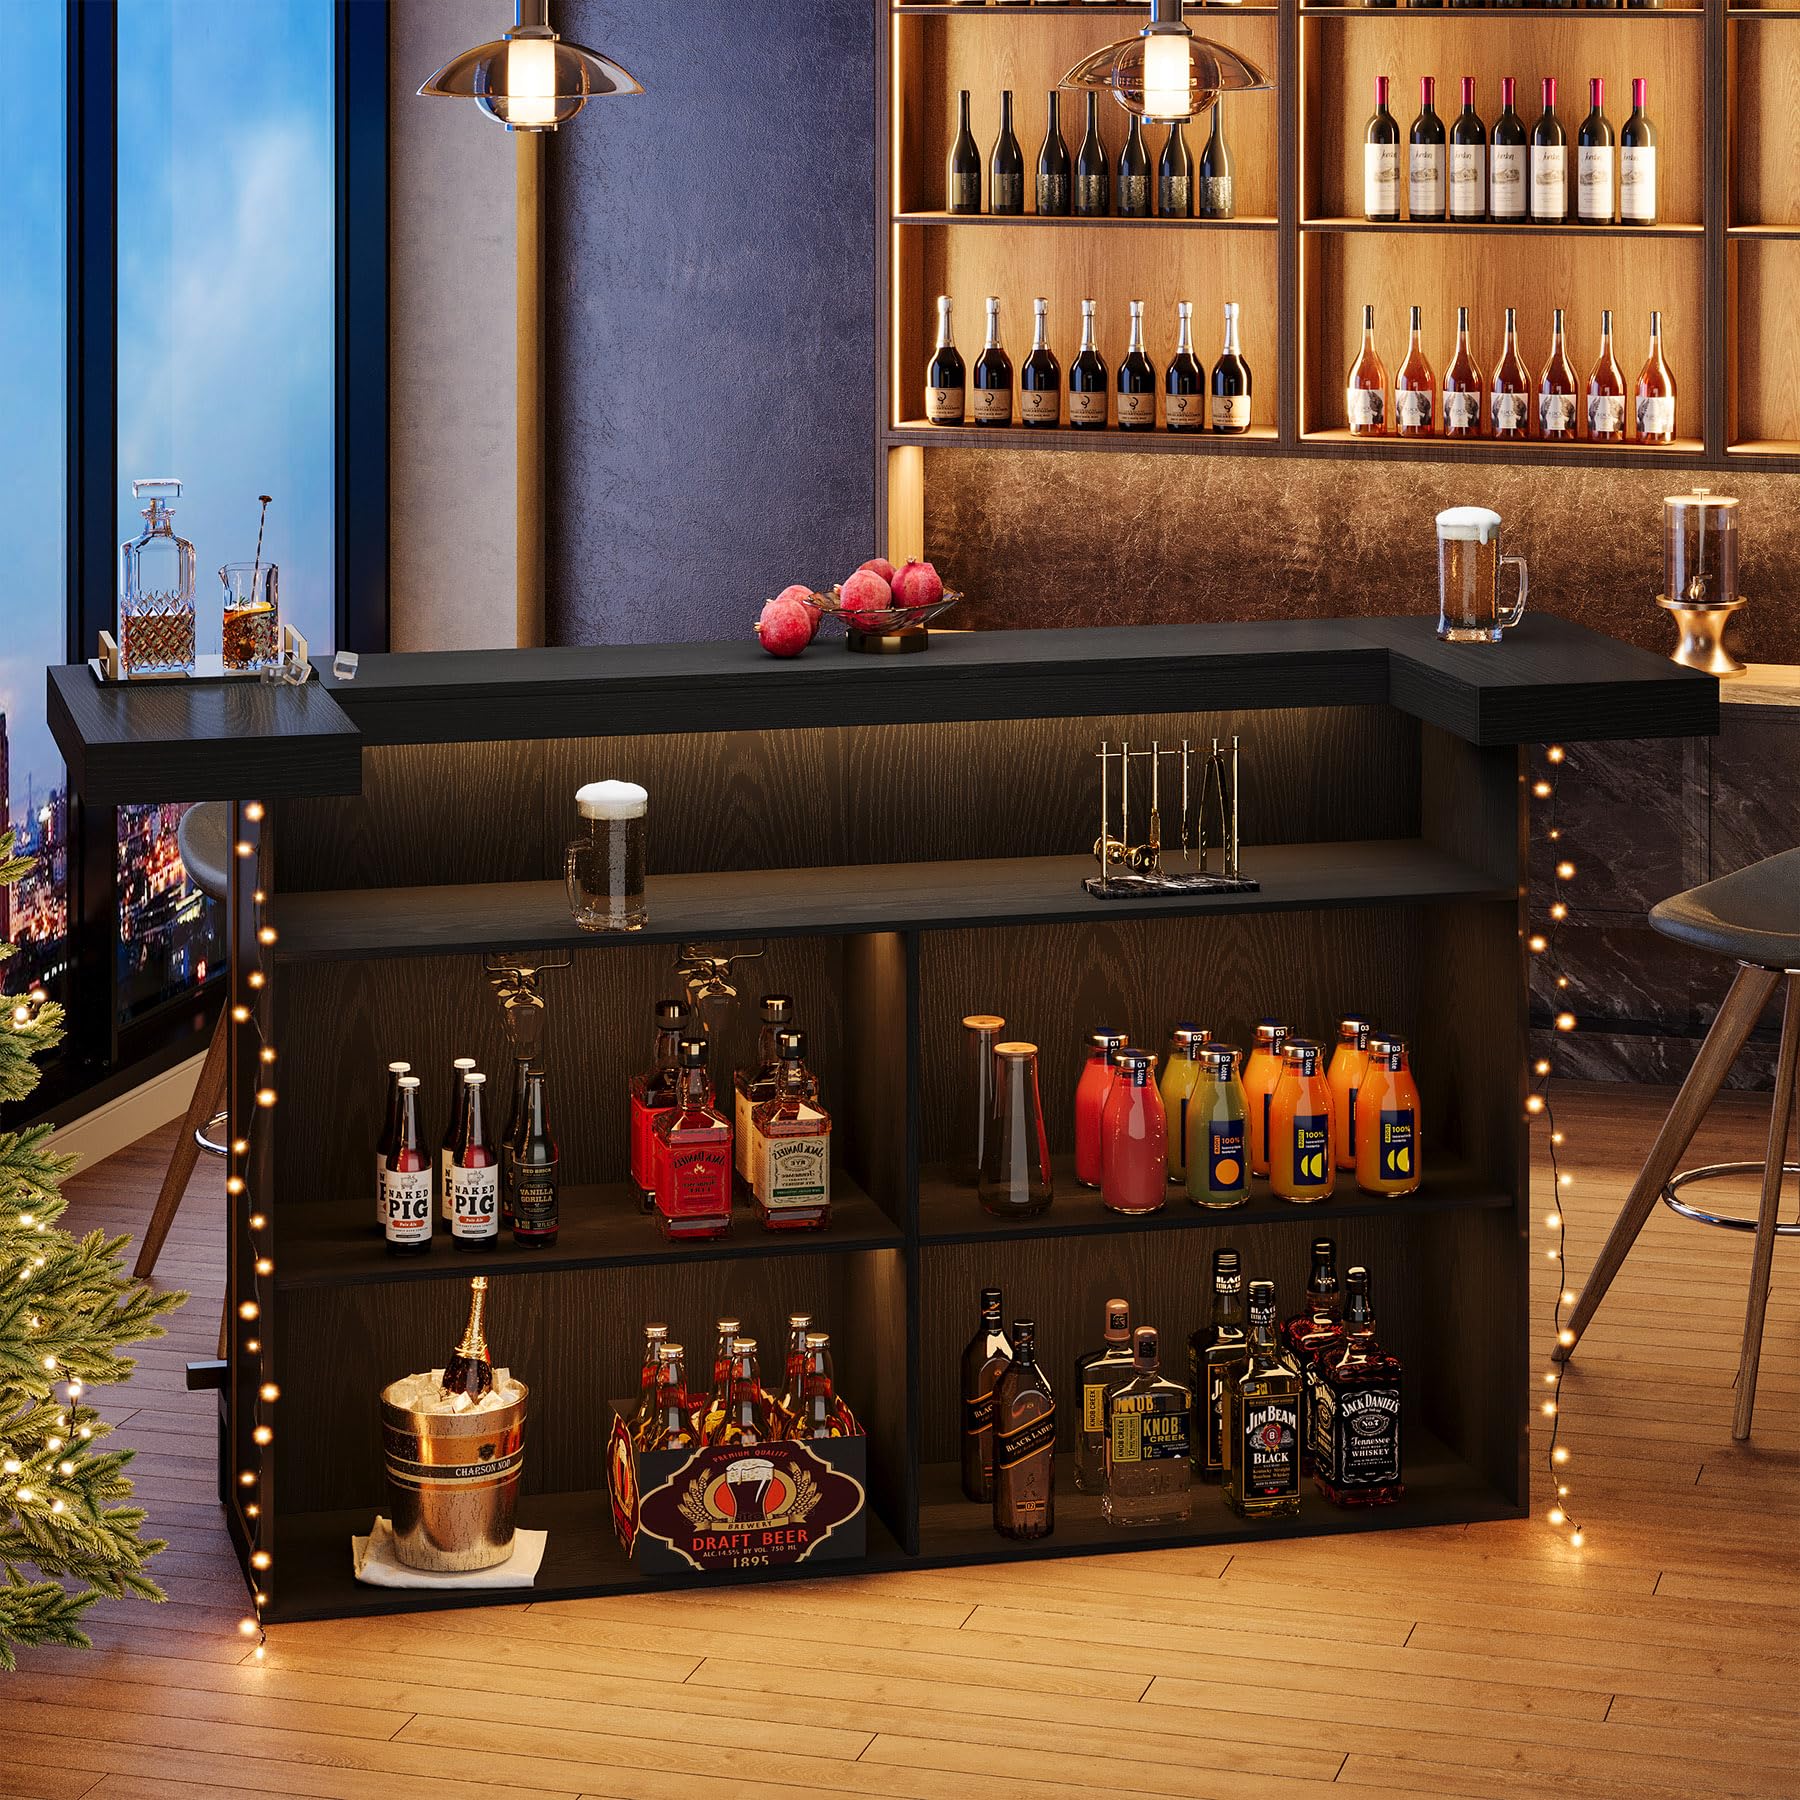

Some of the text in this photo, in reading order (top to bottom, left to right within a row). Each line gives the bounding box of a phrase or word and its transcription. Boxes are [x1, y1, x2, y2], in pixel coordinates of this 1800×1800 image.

[1275, 1029, 1285, 1037] 03
[1360, 1024, 1370, 1032] 03
[1192, 1034, 1203, 1042] 02
[1221, 1055, 1231, 1063] 02
[1305, 1050, 1315, 1058] 03
[1305, 1131, 1325, 1139] 100%
[1392, 1125, 1411, 1134] 100%
[1221, 1136, 1241, 1145] 100%
[388, 1189, 429, 1200] NAKED
[455, 1185, 495, 1196] NAKED
[520, 1188, 554, 1196] VANILLA
[520, 1195, 553, 1203] GORILLA
[388, 1198, 429, 1220] PIG
[455, 1194, 495, 1216] PIG
[1341, 1398, 1366, 1418] JACK
[1365, 1393, 1401, 1415] DANIEL'S
[973, 1404, 994, 1419] BLAC
[1245, 1405, 1297, 1435] JIM BEAM
[1143, 1416, 1180, 1437] KNOB
[1149, 1433, 1186, 1443] CREEK
[1005, 1436, 1032, 1453] BLACK
[713, 1449, 790, 1463] PREMIUM QUALITY
[1143, 1445, 1154, 1459] 12
[1351, 1448, 1391, 1458] WHISKEY
[1253, 1451, 1290, 1466] BLACK
[727, 1520, 773, 1530] BREWERY
[692, 1529, 809, 1552] DRAFT BEER
[732, 1555, 770, 1569] 1895
